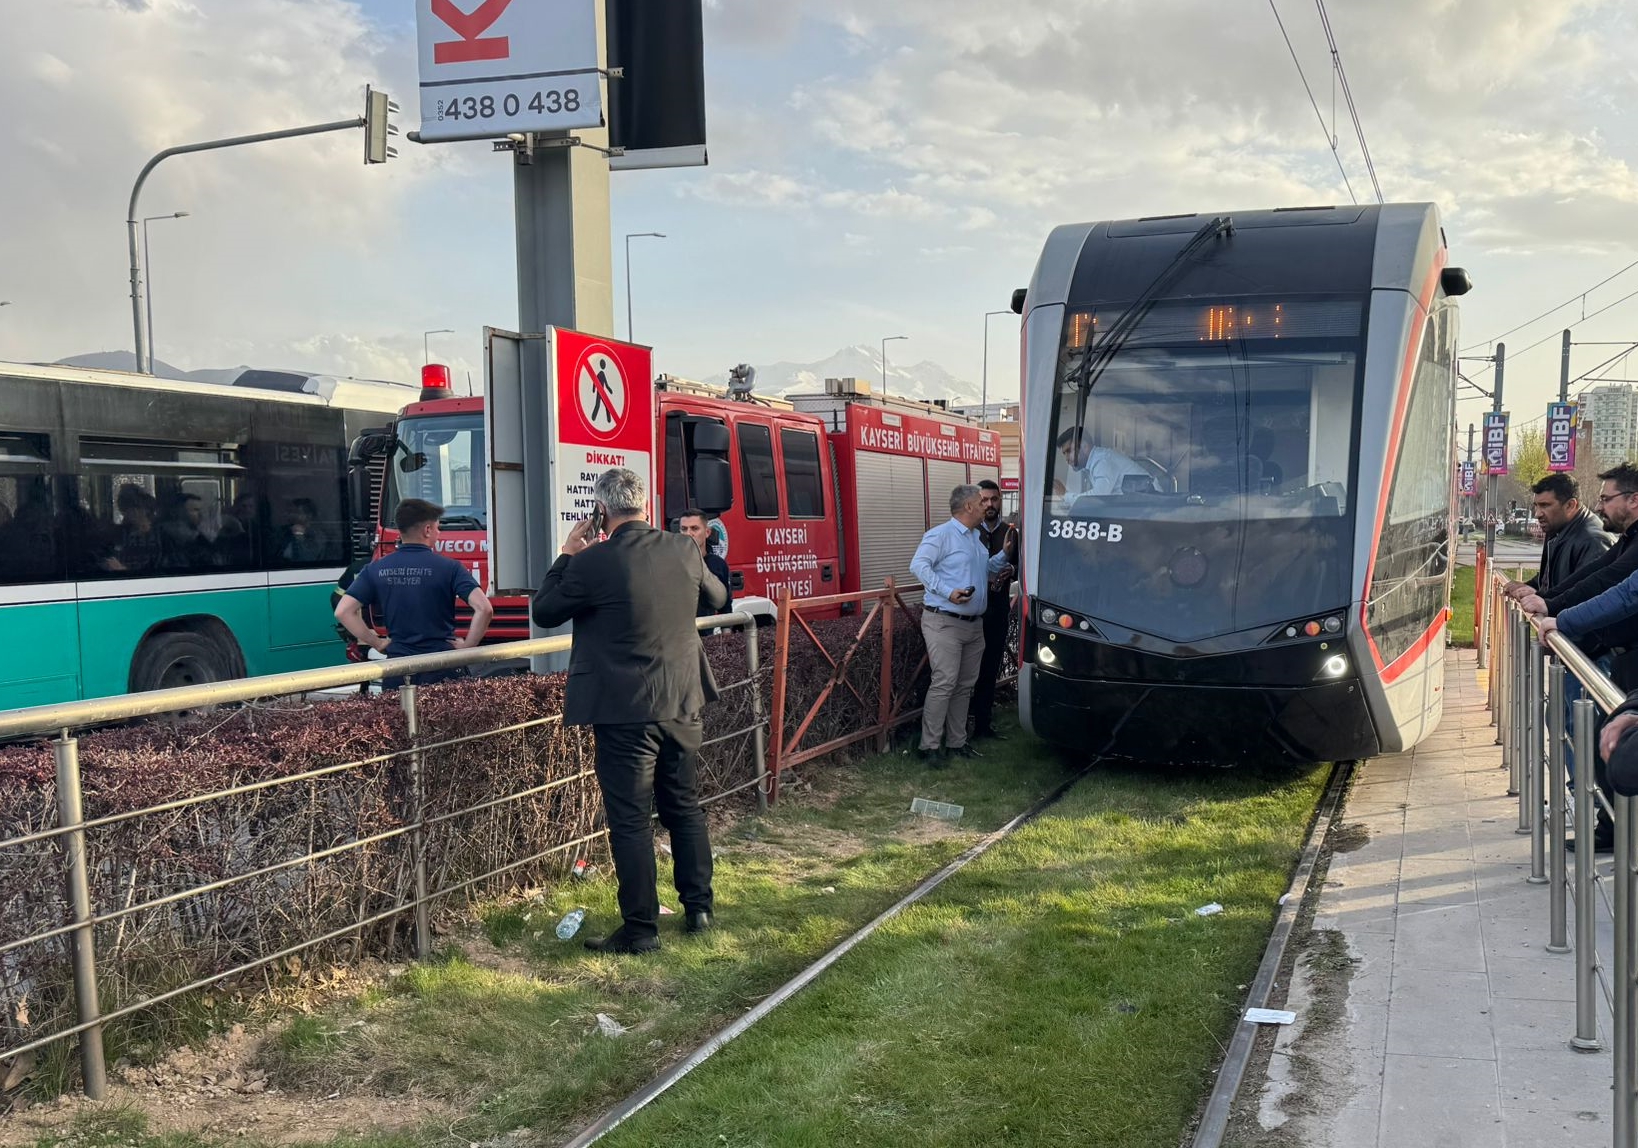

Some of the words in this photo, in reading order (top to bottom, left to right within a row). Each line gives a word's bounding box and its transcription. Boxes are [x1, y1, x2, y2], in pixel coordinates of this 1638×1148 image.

[445, 95, 495, 120] 438
[503, 93, 520, 117] 0
[528, 89, 580, 114] 438
[861, 425, 904, 450] KAYSERİ
[907, 430, 960, 458] BÜYÜKŞEHİR
[963, 438, 997, 462] İTFAİYESİ
[586, 450, 625, 466] DİKKAT!
[574, 499, 595, 508] HATT
[560, 510, 594, 521] TEHLİK
[766, 523, 807, 545] KAYSERİ
[1048, 520, 1123, 542] 3858-B
[431, 540, 475, 552] VECO
[756, 549, 818, 573] BÜYÜKŞEHİR
